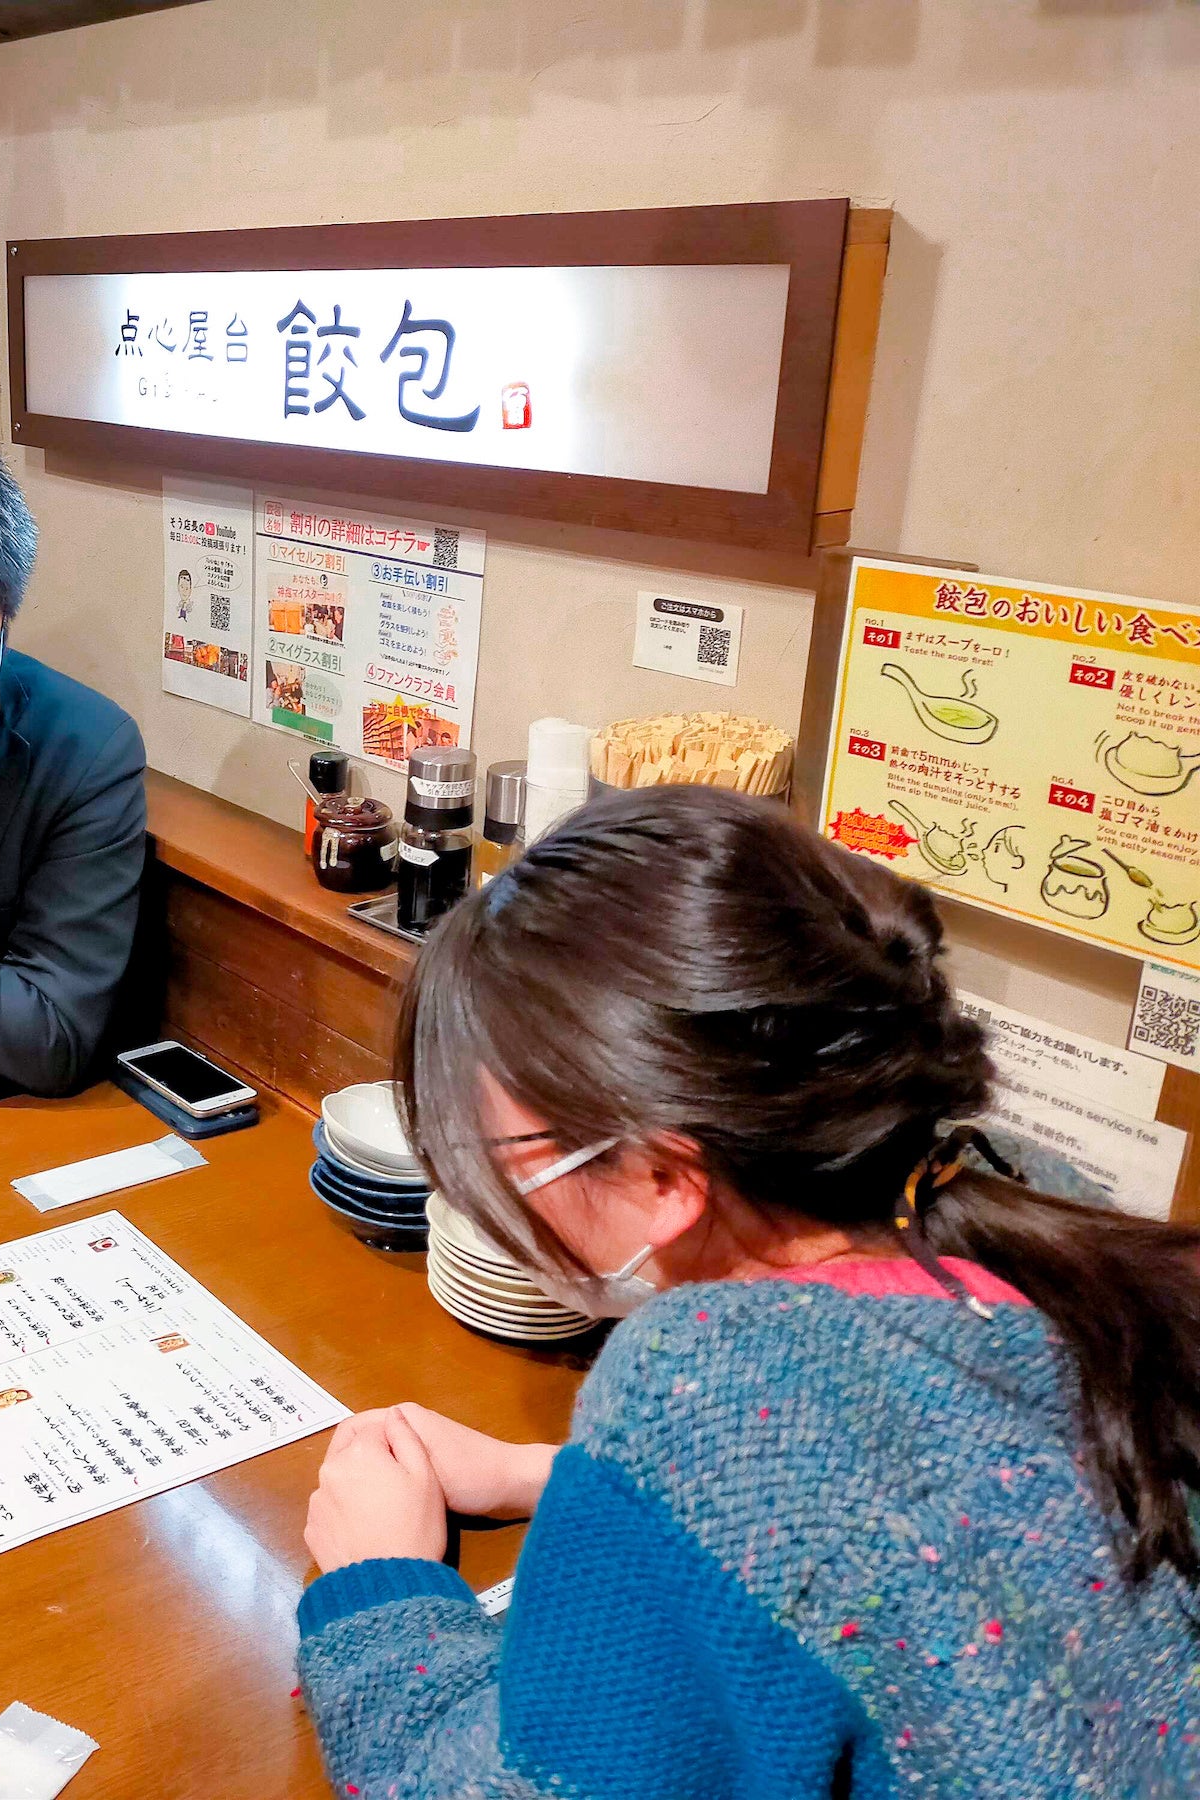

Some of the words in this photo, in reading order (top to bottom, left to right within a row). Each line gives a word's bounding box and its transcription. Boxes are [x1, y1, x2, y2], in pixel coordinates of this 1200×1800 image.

[115, 308, 248, 362] 点心屋台
[275, 298, 482, 434] 餃包
[290, 510, 416, 553] 割引の詳細はコチラ
[867, 631, 893, 645] その1
[904, 646, 928, 656] Taste
[931, 649, 945, 659] the
[948, 652, 969, 663] soup
[1072, 653, 1096, 664] no.2
[1074, 669, 1108, 685] その2
[1121, 670, 1200, 693] 皮を破かない
[1119, 684, 1200, 709] 優しくレン
[1115, 715, 1146, 726] scoop
[1148, 718, 1157, 727] it
[1160, 721, 1173, 732] up
[1117, 703, 1135, 713] Not
[1139, 707, 1150, 716] to
[1154, 709, 1185, 722] break
[852, 743, 881, 758] その3
[887, 773, 905, 783] Bite
[907, 777, 921, 787] the
[922, 780, 963, 798] dumpling
[1051, 775, 1074, 786] no.4
[887, 782, 906, 793] then
[924, 790, 939, 800] the
[941, 795, 963, 806] meat
[1053, 790, 1089, 809] その4
[1096, 835, 1118, 846] with
[1120, 842, 1148, 854] salty
[1119, 830, 1138, 840] can
[1141, 835, 1164, 847] also
[1167, 842, 1198, 856] enjoy
[1032, 1090, 1048, 1102] an
[1051, 1098, 1083, 1116] extra
[1087, 1110, 1132, 1135] service
[1136, 1128, 1159, 1146] fee
[175, 1362, 252, 1431] やみつきポテトフライ
[229, 1383, 272, 1423] 台湾チキン
[249, 1377, 298, 1414] 麻婆豆腐
[118, 1392, 186, 1457] 海老蒸し春巻き
[188, 1404, 232, 1440] 豚の角煮
[43, 1415, 109, 1485] 海老入りシューマイ
[65, 1403, 134, 1475] 青唐辛子のシューマイ
[111, 1417, 162, 1467] 揚げ春巻き
[42, 1451, 84, 1494] 肉シューマイ
